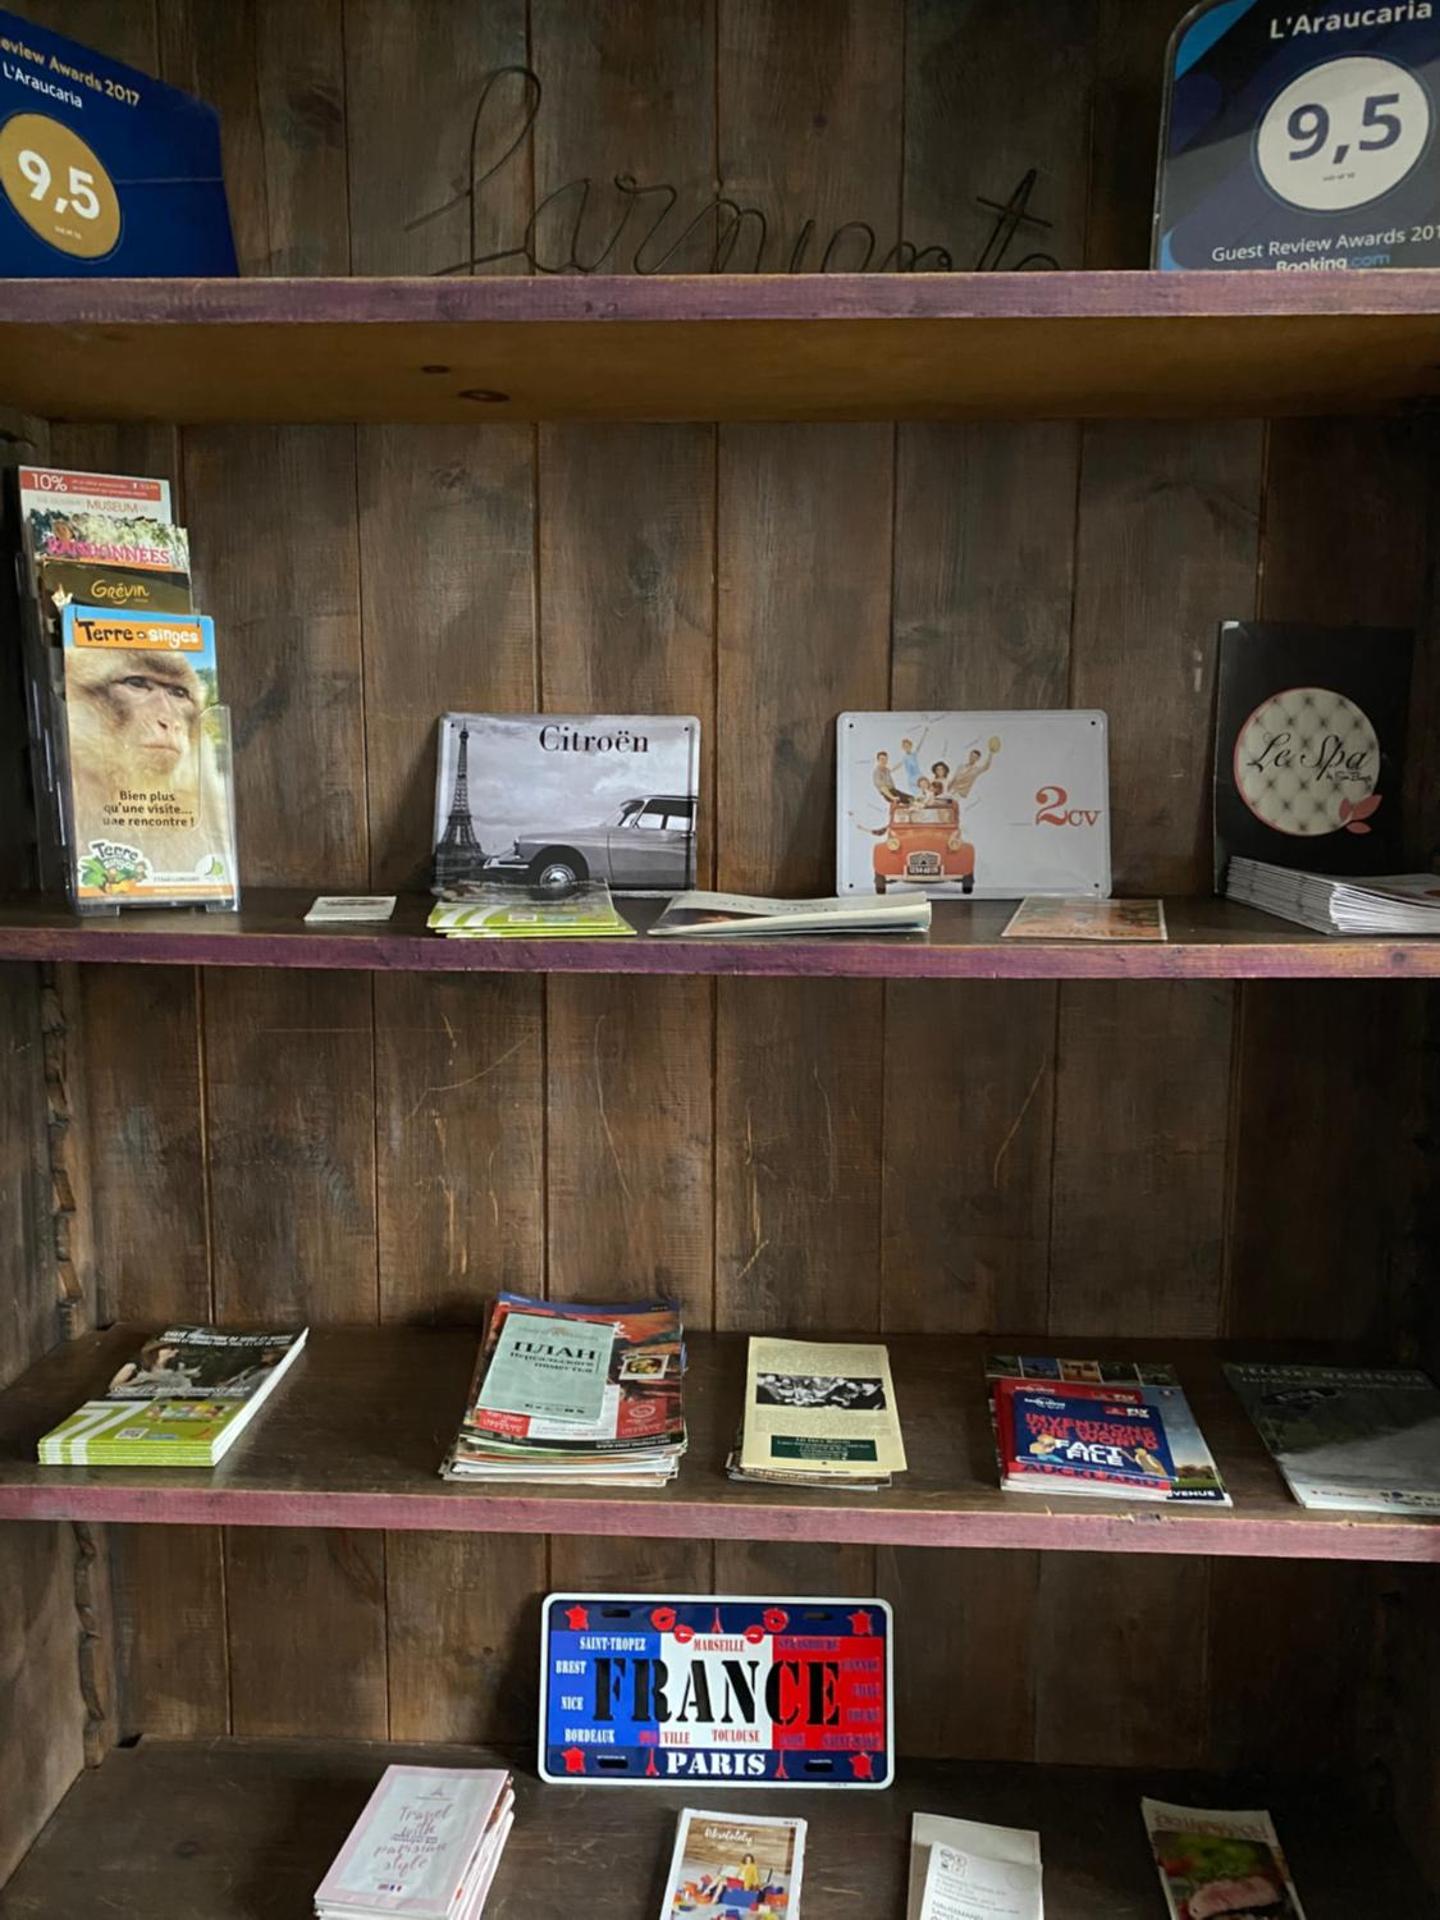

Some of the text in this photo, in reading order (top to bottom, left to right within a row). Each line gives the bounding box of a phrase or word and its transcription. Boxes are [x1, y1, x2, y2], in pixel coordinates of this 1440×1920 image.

[1270, 1, 1432, 39] L'Araucaria
[3, 62, 83, 109] L'Araucaria
[50, 57, 102, 92] Awards
[105, 80, 140, 107] 2017
[1287, 93, 1401, 165] 9,5
[18, 149, 100, 220] 9,5
[1212, 244, 1263, 262] Guest
[1269, 237, 1332, 256] Review
[1335, 227, 1405, 249] Awards
[31, 472, 68, 492] 10%
[78, 621, 133, 642] Terre
[147, 628, 199, 648] singes
[539, 724, 649, 753] Citroën
[1246, 732, 1369, 781] Le Spa
[103, 802, 145, 815] qu'une
[119, 790, 175, 803] Bien plus
[128, 816, 187, 827] rencontre
[1054, 1438, 1122, 1457] FACT
[579, 1636, 646, 1651] SAINT-TROPEZ
[694, 1639, 745, 1652] MARSEILLE
[556, 1660, 587, 1674] BREST
[593, 1658, 839, 1727] FRANCE
[565, 1728, 615, 1744] BORDEAUX
[713, 1729, 760, 1742] TOULOUSE
[667, 1751, 766, 1776] PARIS
